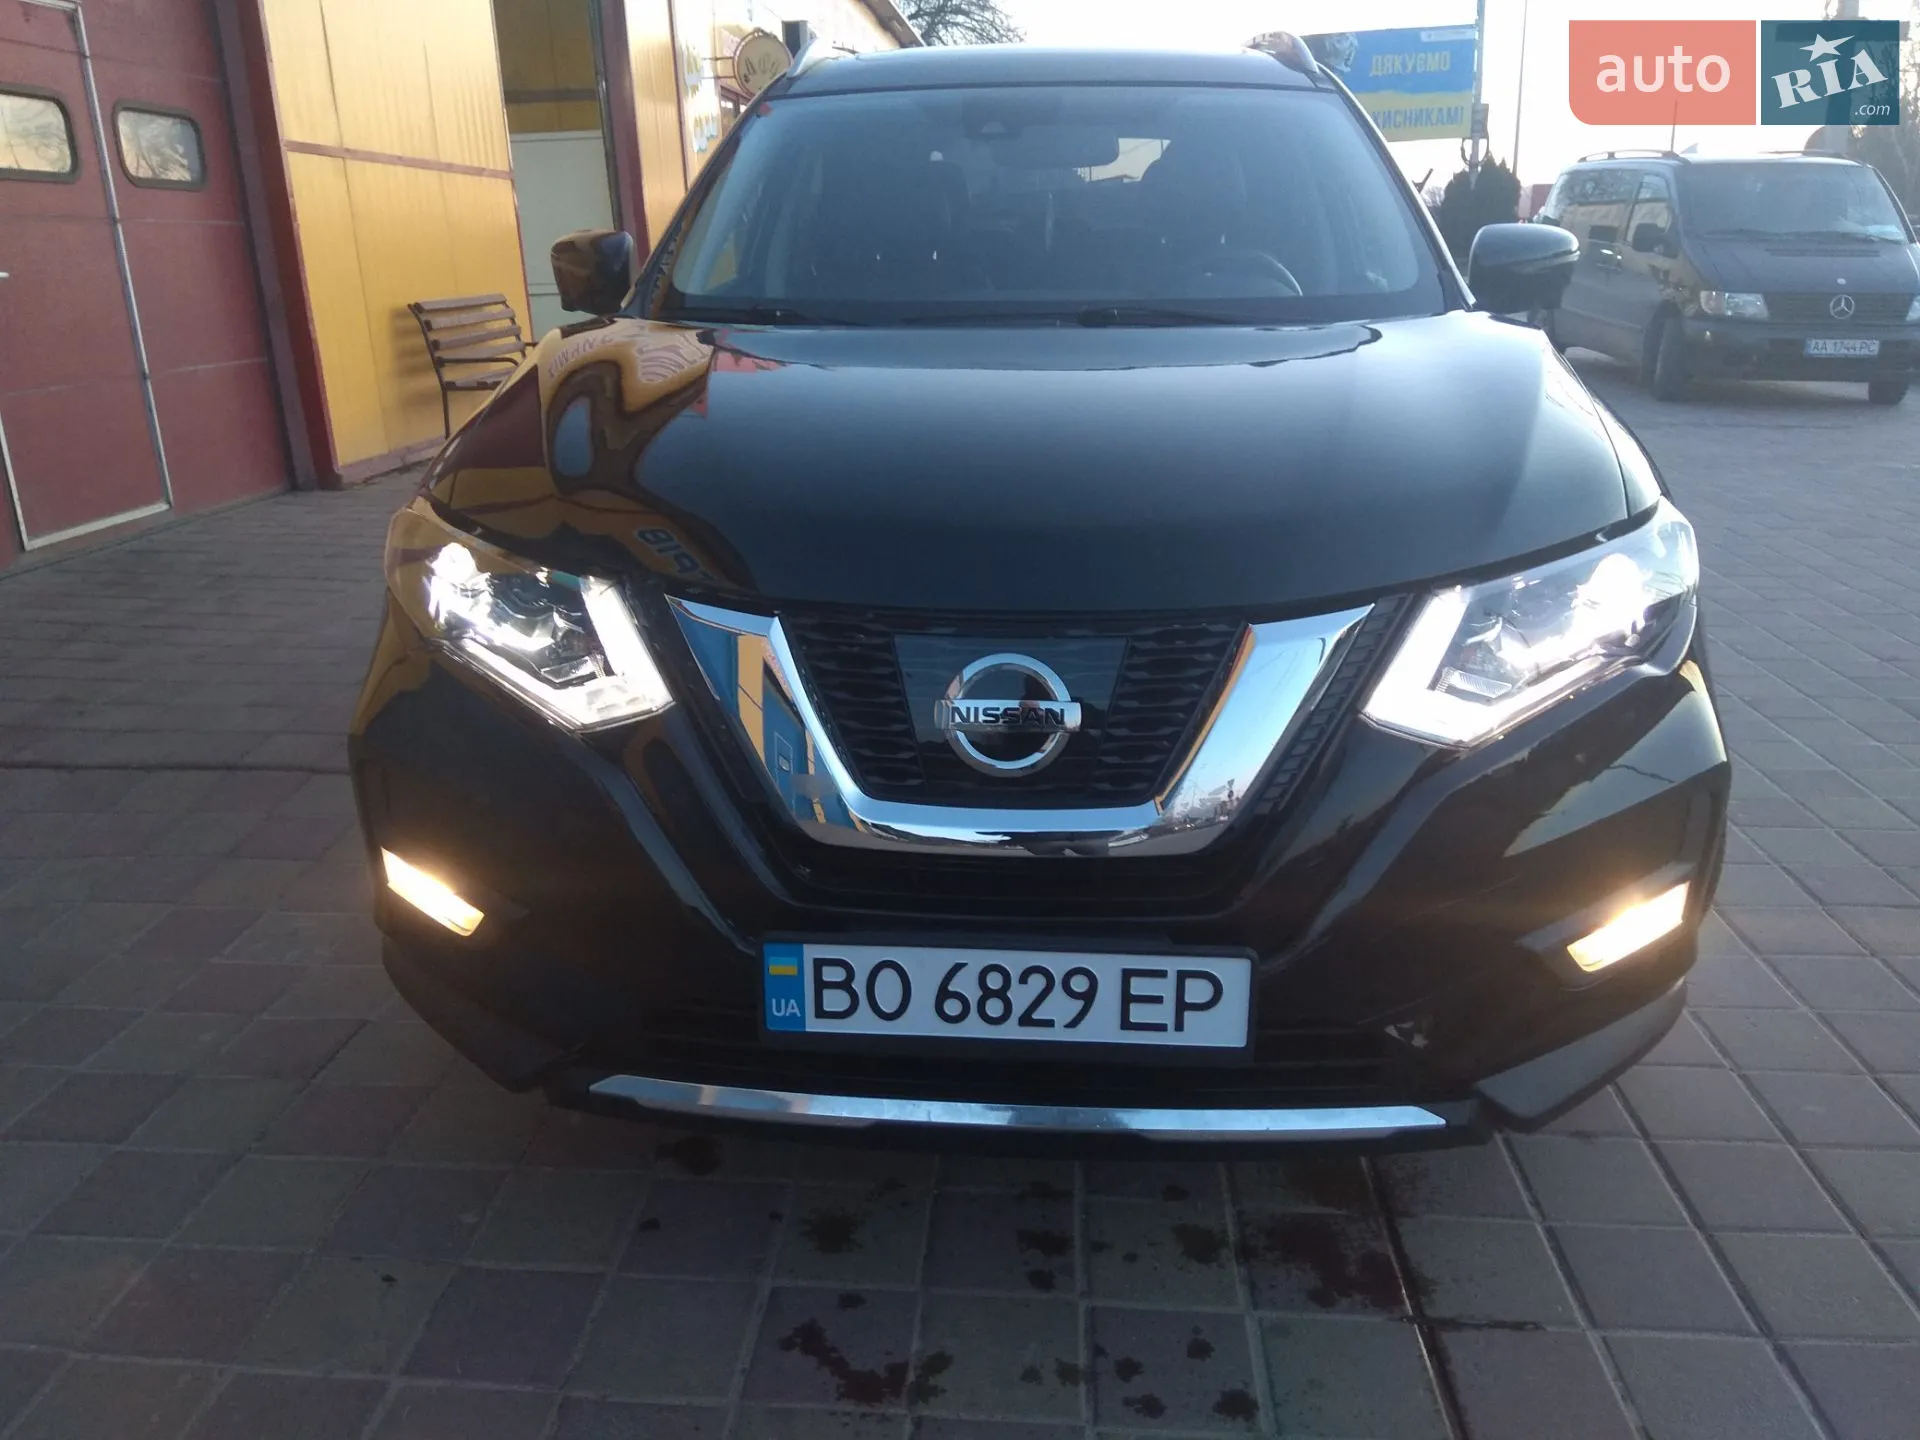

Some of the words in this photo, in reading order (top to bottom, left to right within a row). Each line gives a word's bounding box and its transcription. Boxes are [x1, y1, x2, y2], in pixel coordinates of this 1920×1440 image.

[951, 705, 1066, 725] NISSAN
[812, 957, 912, 1022] BO
[934, 962, 1099, 1030] 6829
[1119, 967, 1224, 1033] EP
[771, 998, 801, 1018] UA
